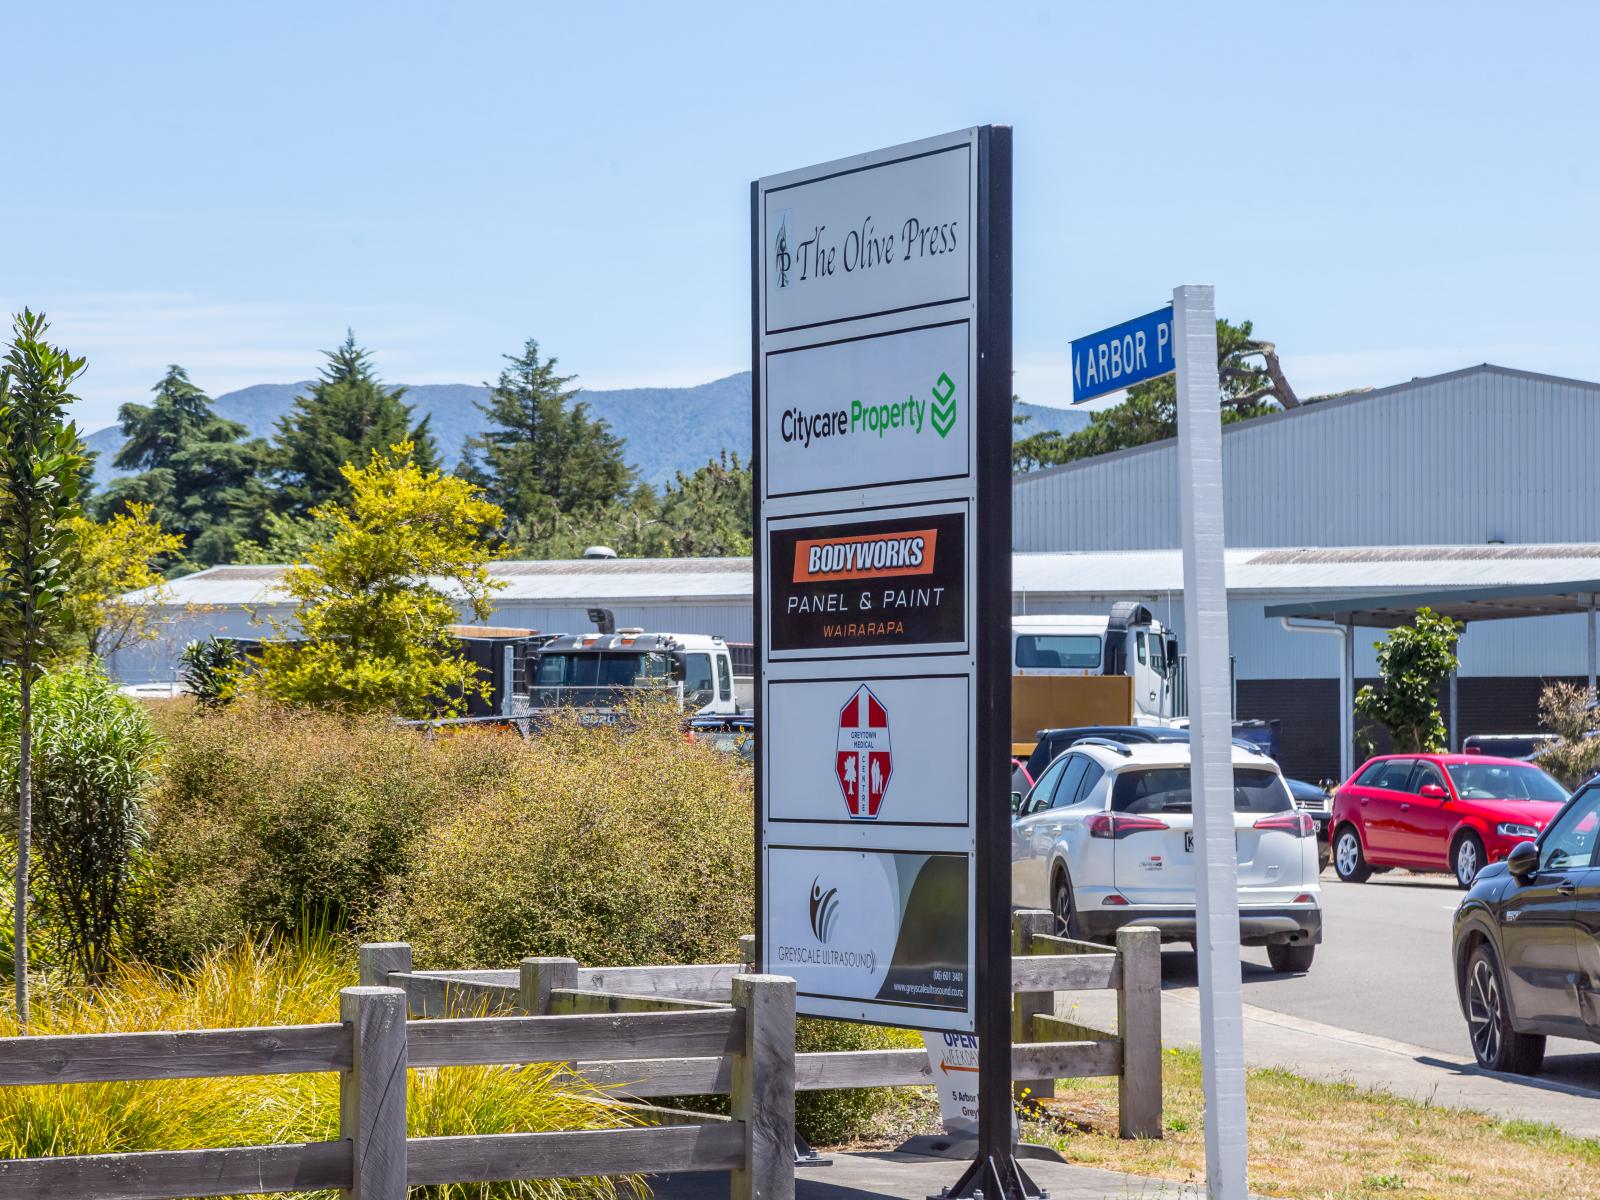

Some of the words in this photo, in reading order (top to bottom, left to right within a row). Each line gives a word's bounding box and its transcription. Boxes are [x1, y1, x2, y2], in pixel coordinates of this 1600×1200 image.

[796, 225, 836, 281] The
[843, 215, 894, 272] Olive
[901, 217, 958, 261] Press
[1086, 330, 1147, 387] ARBOR
[781, 407, 848, 448] Citycare
[850, 395, 926, 438] Property
[807, 536, 924, 574] BODYWORKS
[787, 593, 848, 614] PANEL
[859, 591, 872, 610] &
[883, 587, 945, 609] PAINT
[823, 621, 904, 638] WAIRARAPA
[850, 731, 877, 739] GREYTOWN
[853, 740, 874, 748] MEDICAL
[778, 945, 821, 965] GREYSCALE
[822, 949, 873, 970] ULTRASOUND
[943, 1032, 977, 1049] OPEN
[952, 1090, 957, 1101] 5
[958, 1091, 976, 1102] Arbor
